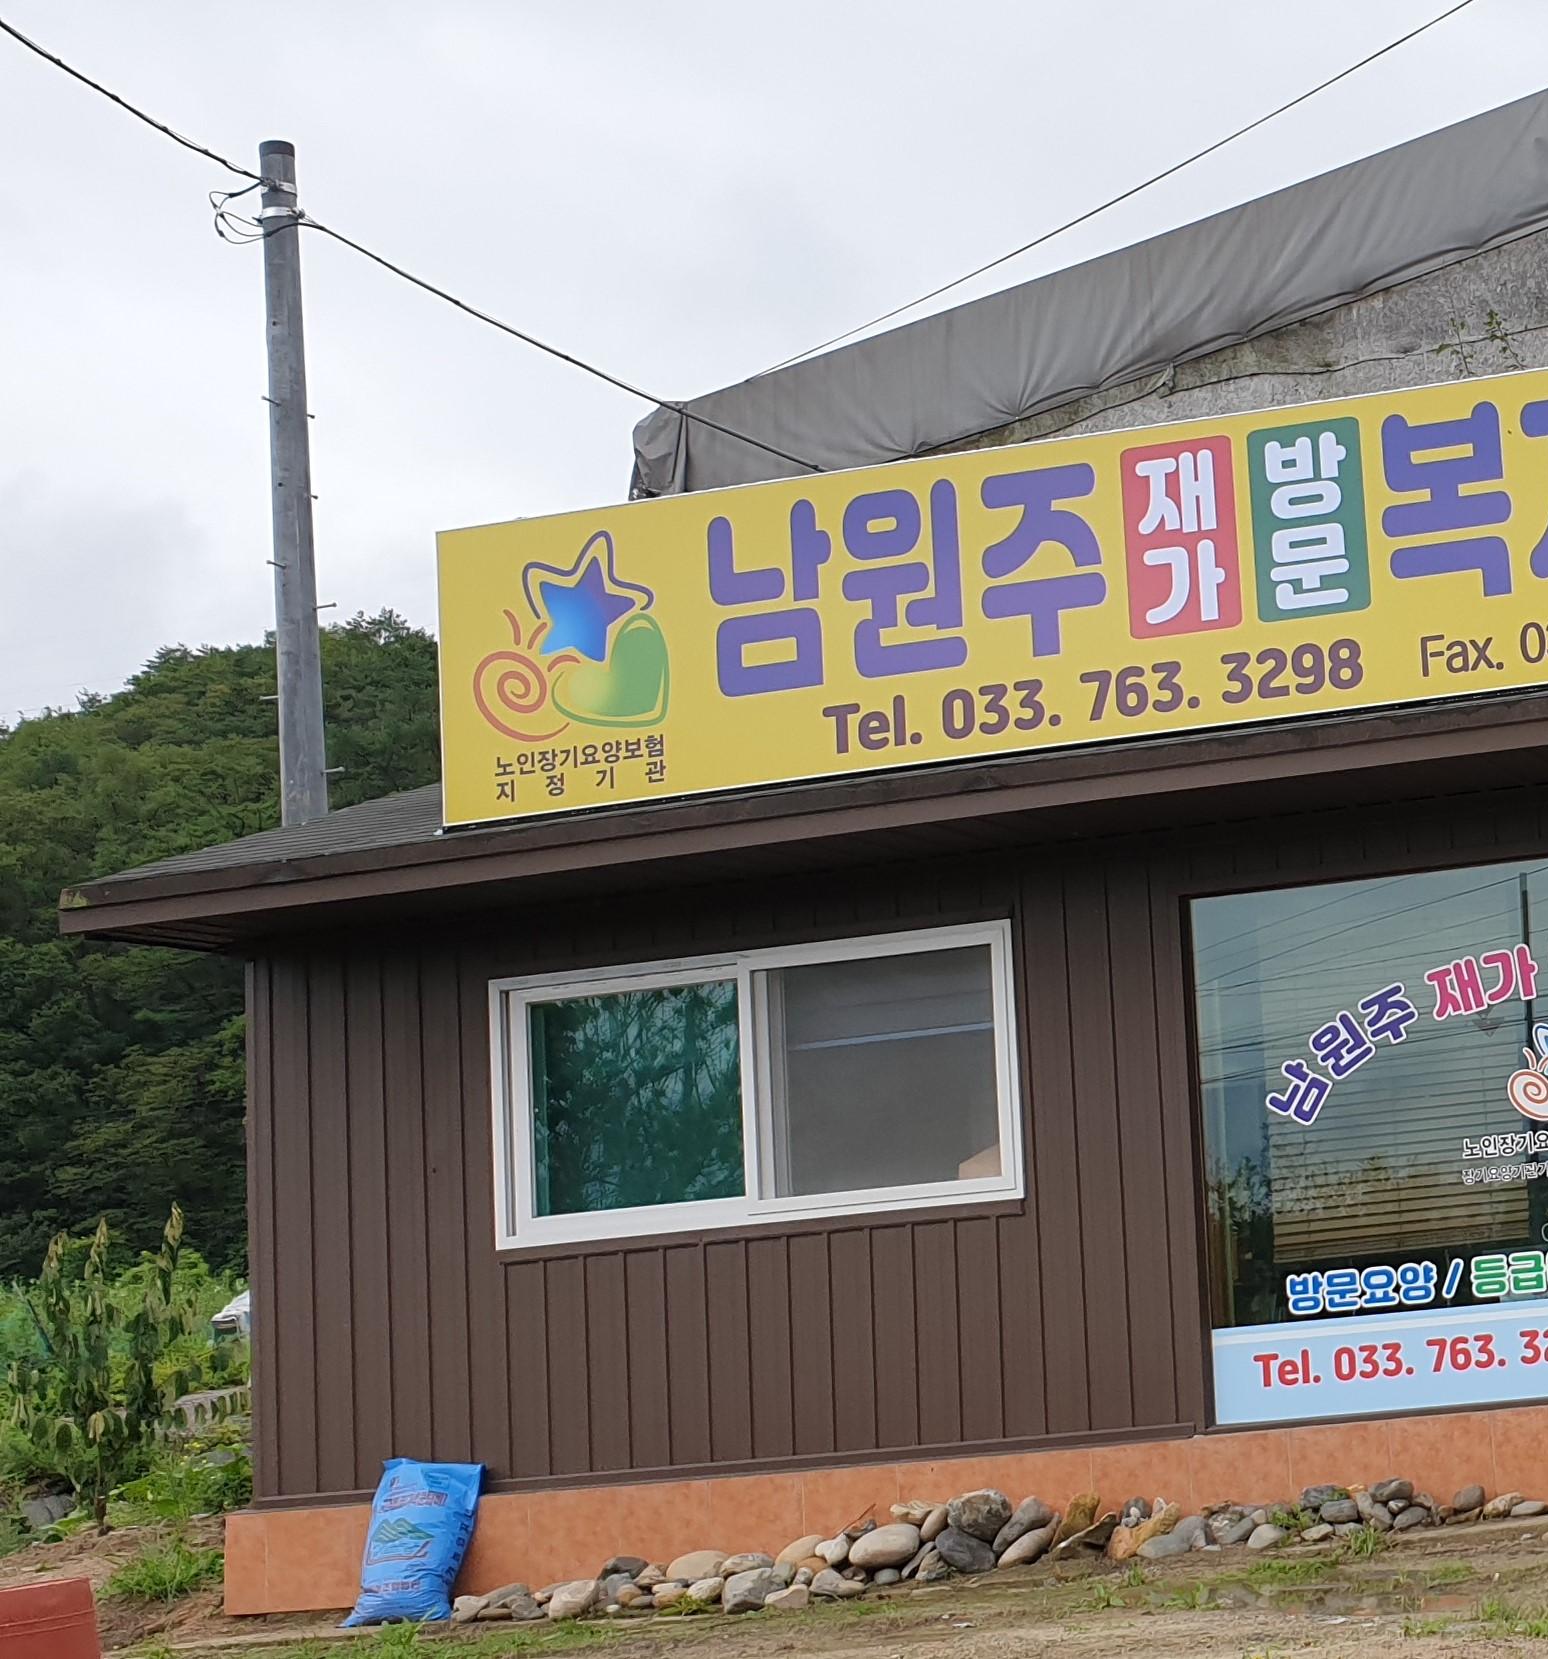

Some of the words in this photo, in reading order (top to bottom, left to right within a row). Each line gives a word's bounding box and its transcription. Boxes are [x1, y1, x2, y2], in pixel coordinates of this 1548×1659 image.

[706, 462, 1107, 698] 남원주
[1134, 447, 1227, 625] 재가
[1263, 430, 1353, 611] 방문
[1419, 634, 1504, 678] Fax.
[822, 694, 923, 755] Tel.
[941, 682, 1062, 739] 033.
[1079, 660, 1201, 721] 763.
[1220, 637, 1364, 702] 3298
[494, 733, 666, 778] 노인장기요양보험
[1265, 981, 1419, 1127] 남원주
[1425, 941, 1539, 1021] 재가
[1286, 1263, 1437, 1317] 방문요양
[1252, 1350, 1322, 1389] Tel.
[1333, 1341, 1416, 1383] 033.
[1426, 1331, 1508, 1375] 763.
